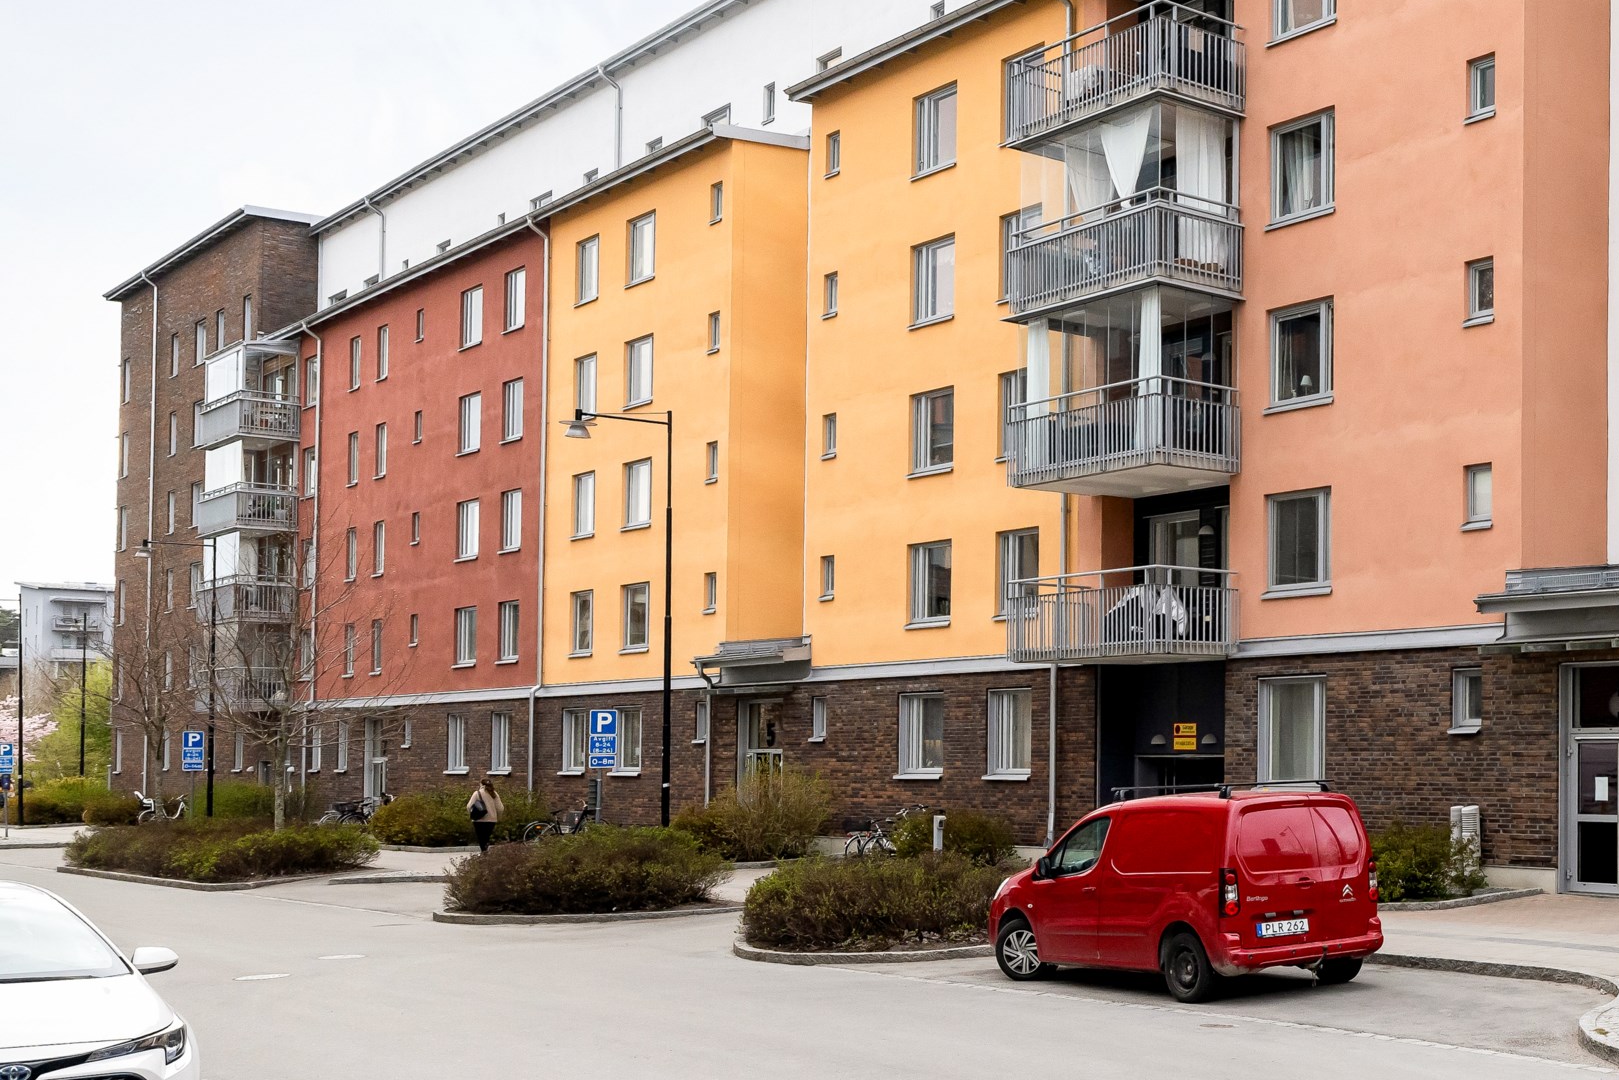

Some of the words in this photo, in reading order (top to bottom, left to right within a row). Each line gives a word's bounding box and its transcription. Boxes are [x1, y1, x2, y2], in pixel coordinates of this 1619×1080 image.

[596, 712, 613, 733] P
[188, 732, 201, 747] P
[766, 722, 776, 747] 5
[0, 744, 10, 756] P
[1265, 922, 1285, 933] PLR
[1286, 920, 1305, 932] 262
